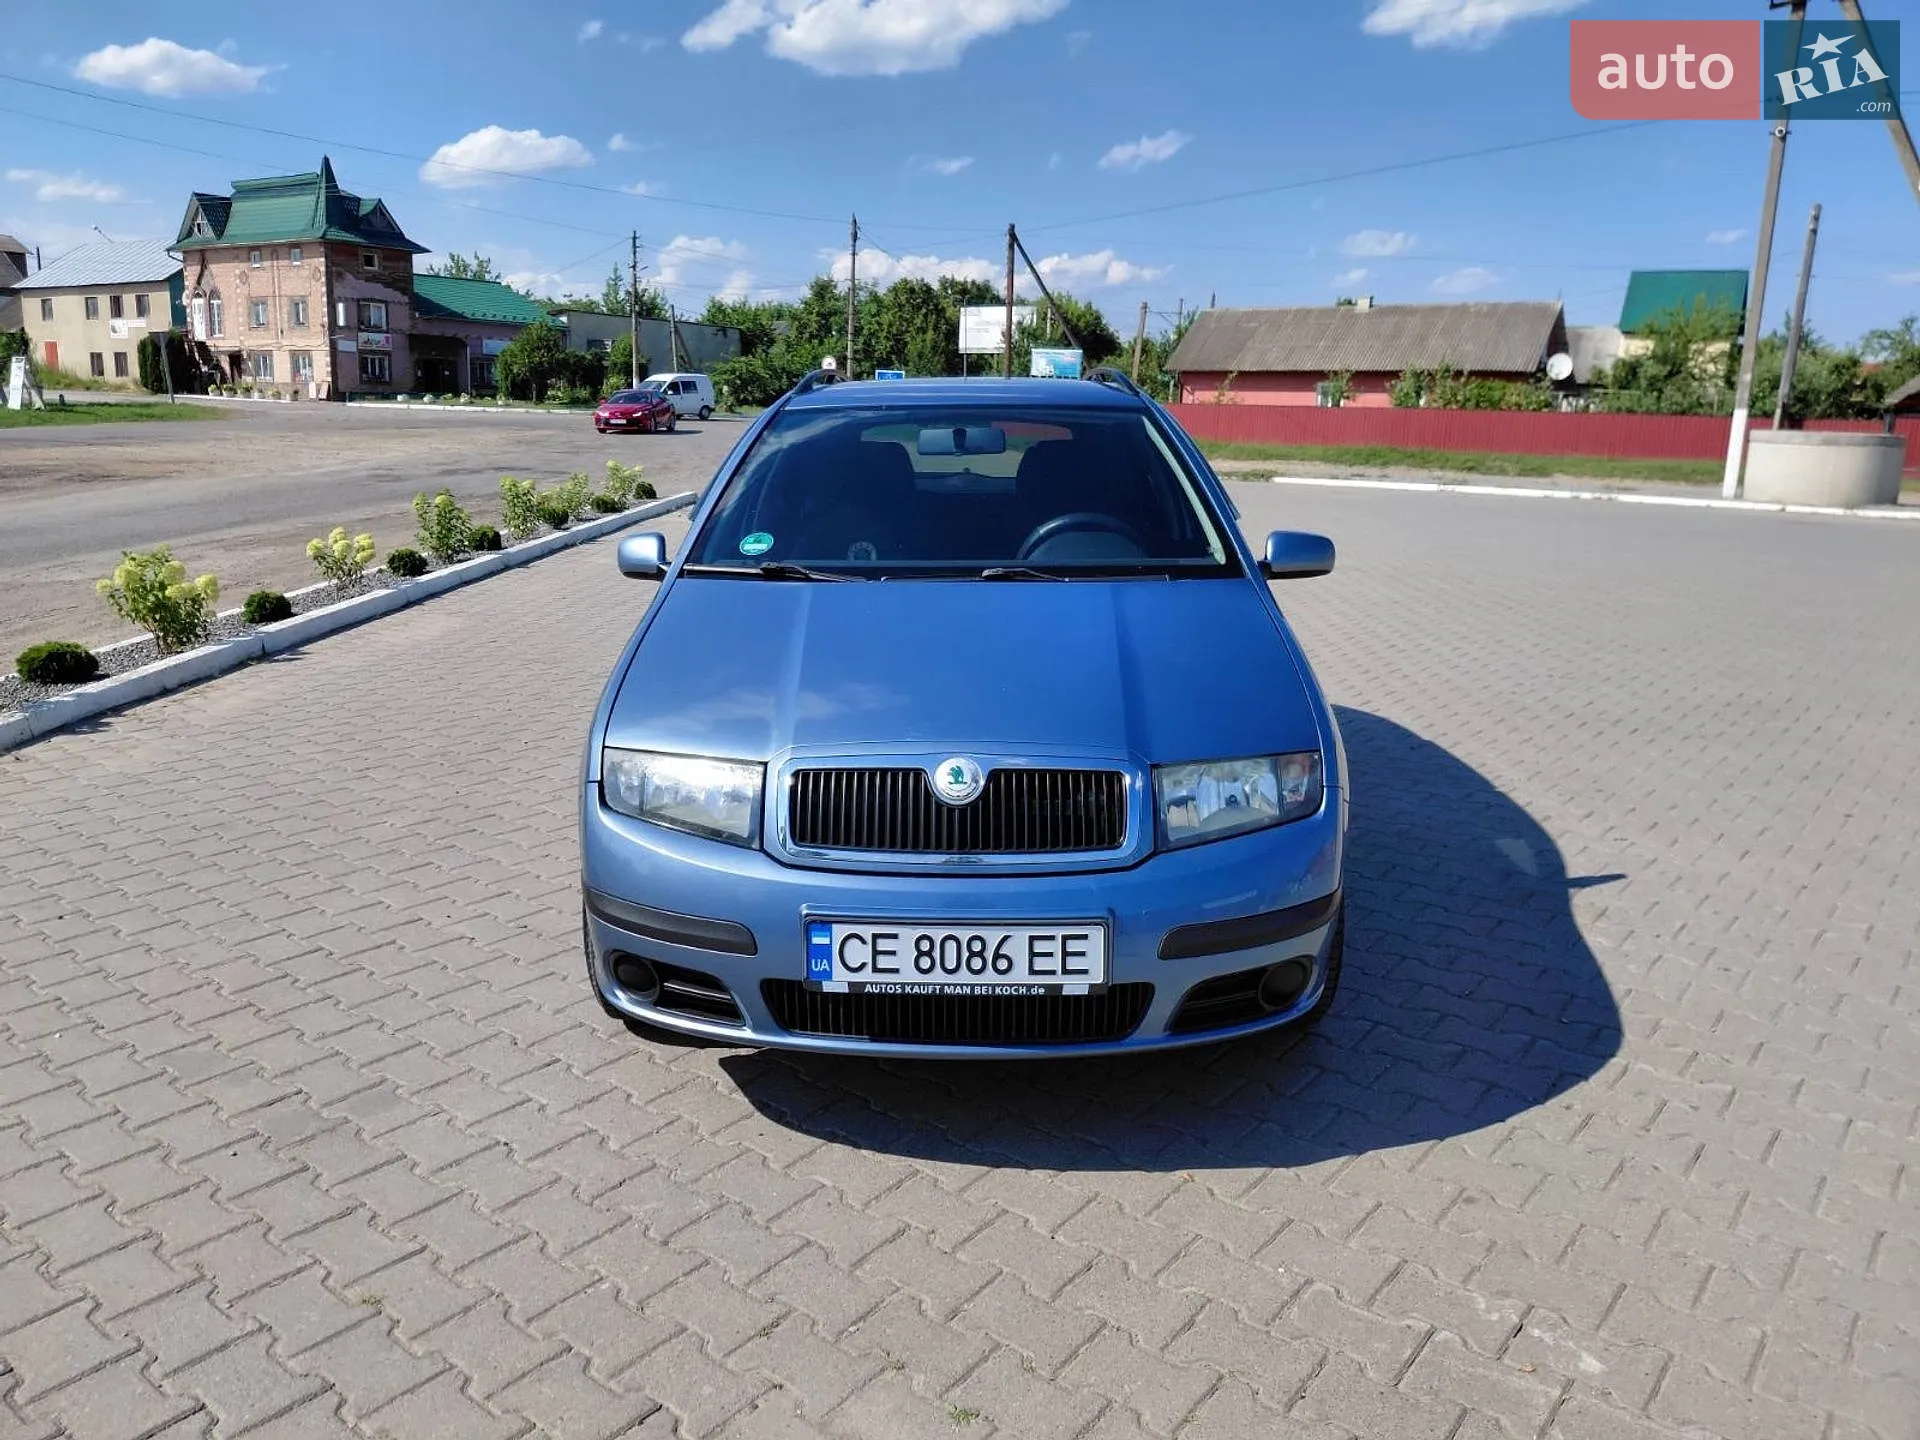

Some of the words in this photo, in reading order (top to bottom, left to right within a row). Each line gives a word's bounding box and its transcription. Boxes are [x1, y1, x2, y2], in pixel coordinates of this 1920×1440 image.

[837, 932, 900, 974] CE
[913, 933, 1016, 975] 8086
[1027, 934, 1090, 976] EE
[811, 959, 831, 971] UA
[864, 983, 902, 993] AUTOS
[904, 984, 941, 994] KAUFT
[944, 985, 971, 995] MAN
[974, 986, 992, 995] BEI
[995, 986, 1046, 995] KOCH.de
